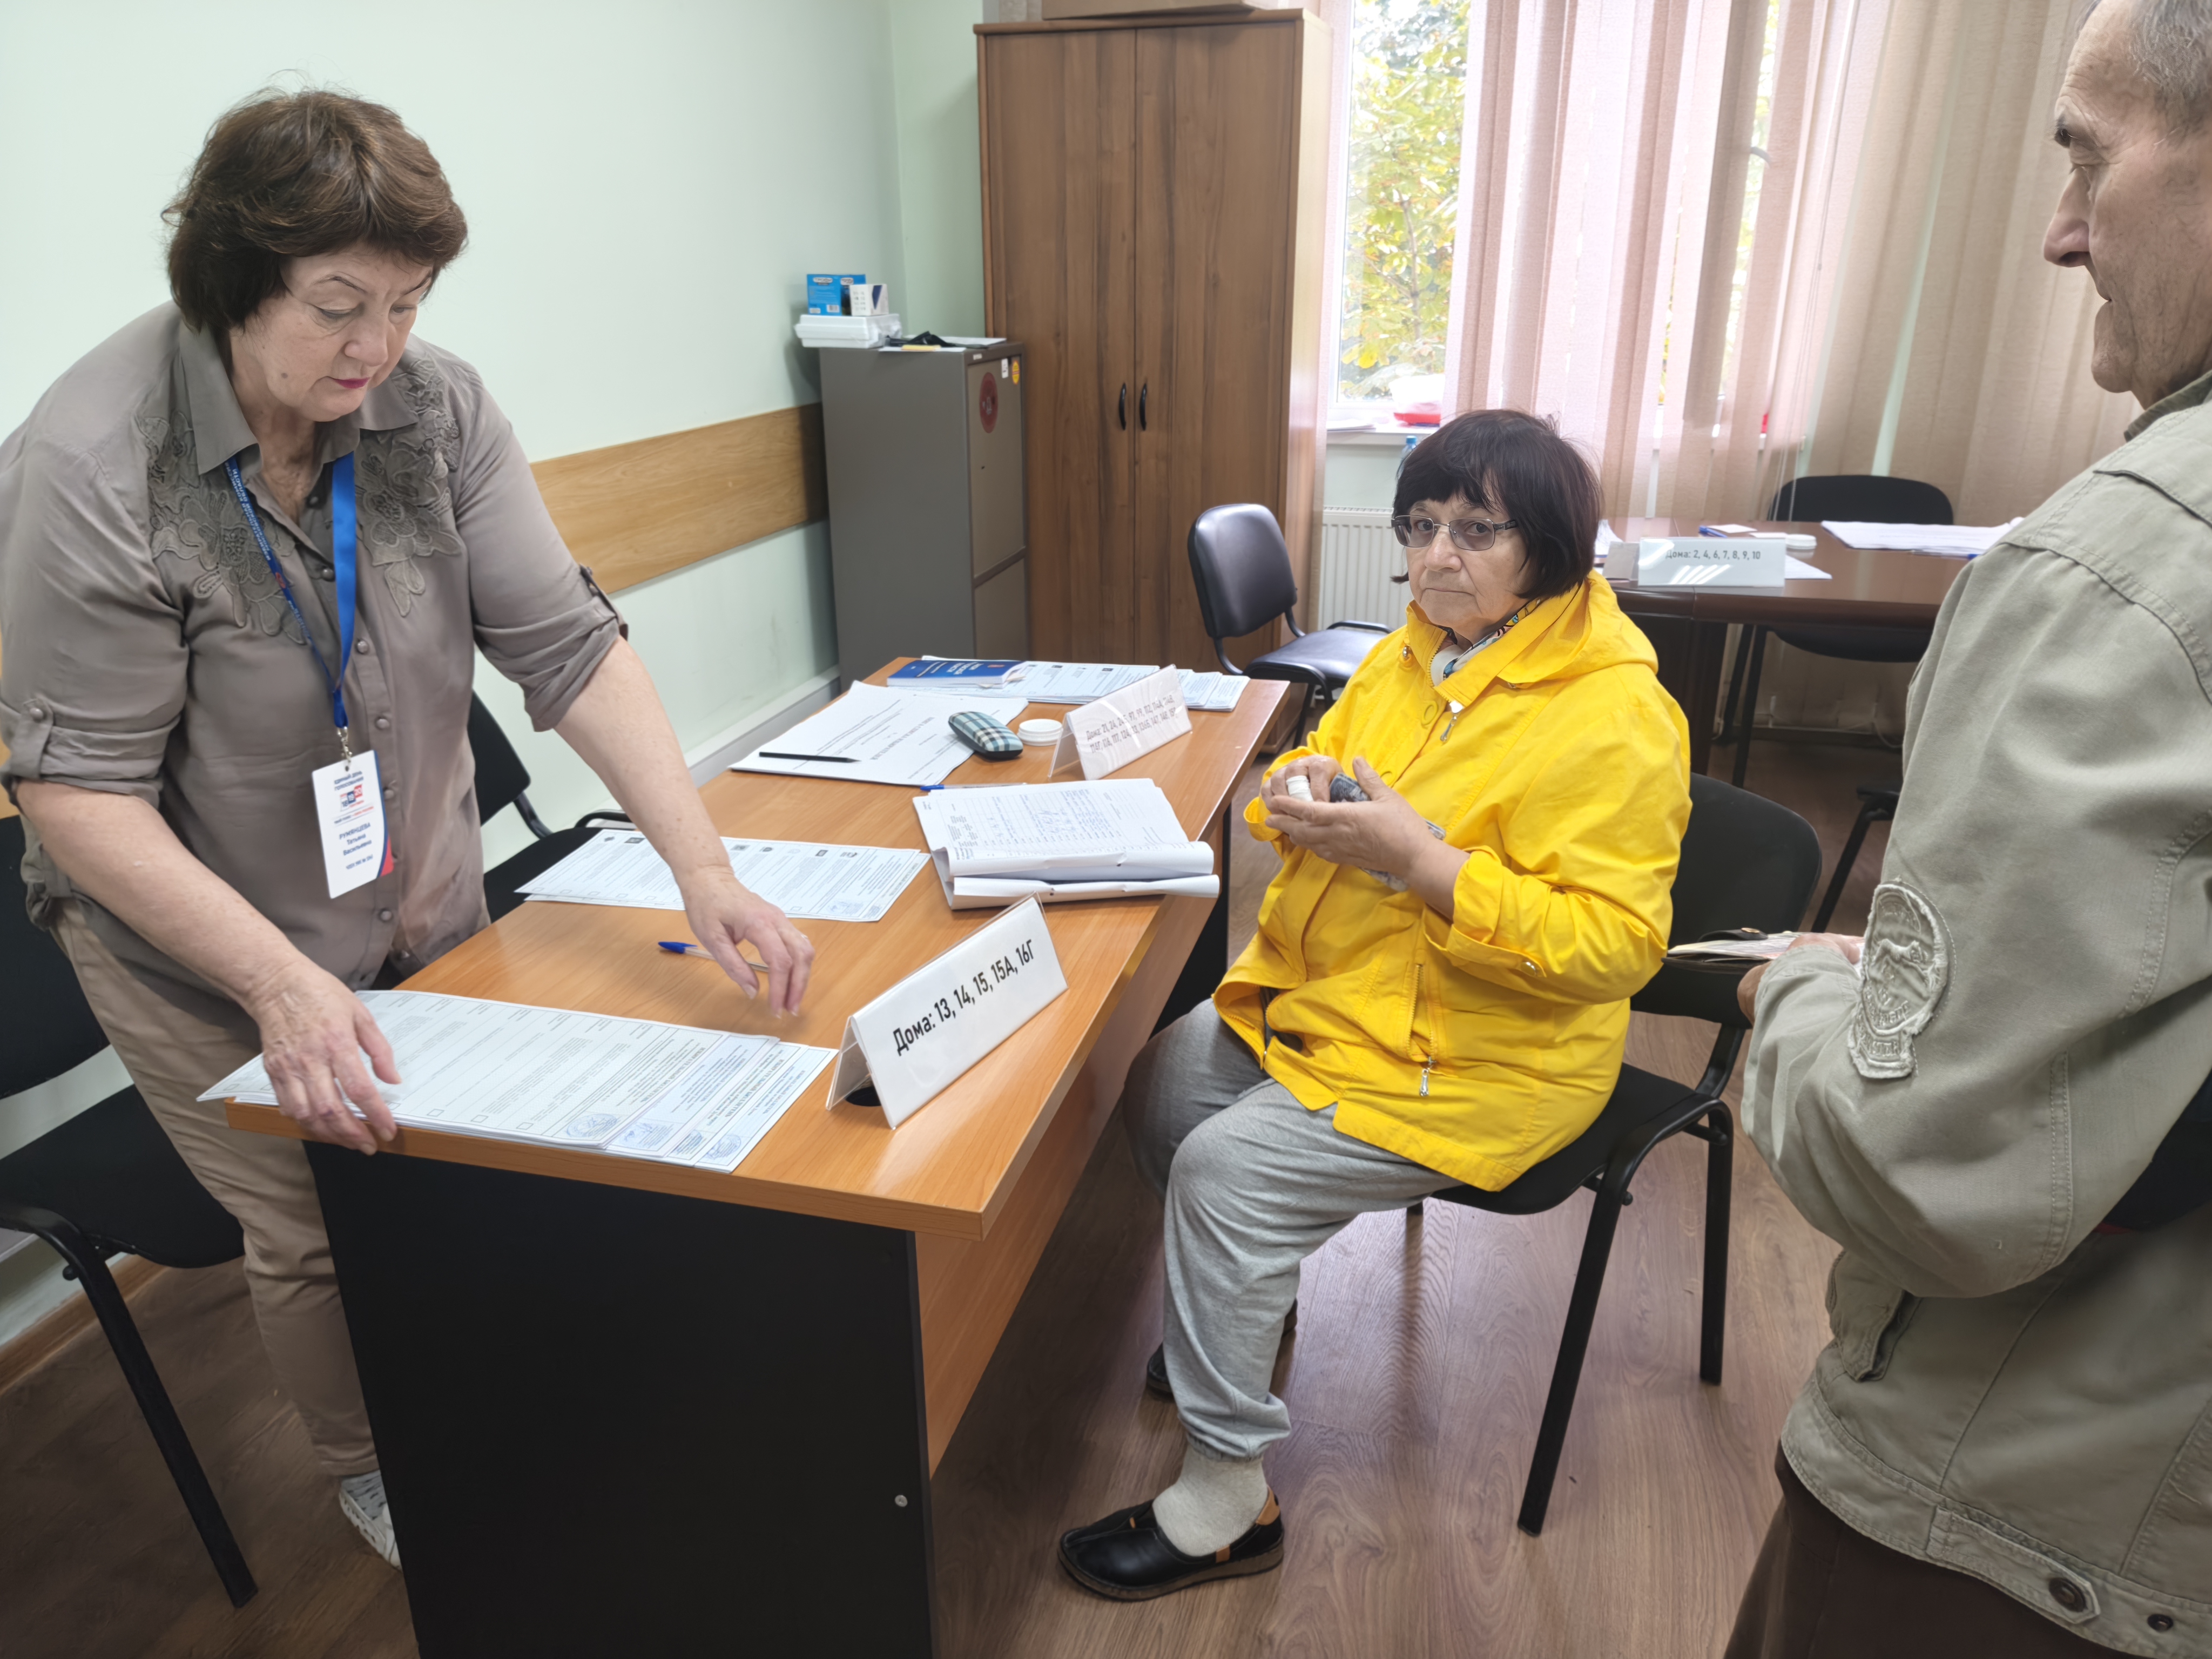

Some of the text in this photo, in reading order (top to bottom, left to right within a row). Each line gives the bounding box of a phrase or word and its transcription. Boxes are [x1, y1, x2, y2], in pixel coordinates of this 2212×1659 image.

[232, 468, 248, 502] ОБЛАСТИ
[1665, 549, 1761, 561] Дома: 2, 4, 6, 7, 8, 9, 10
[893, 939, 1034, 1056] Дома: 13, 14, 15, 15А, 16Г
